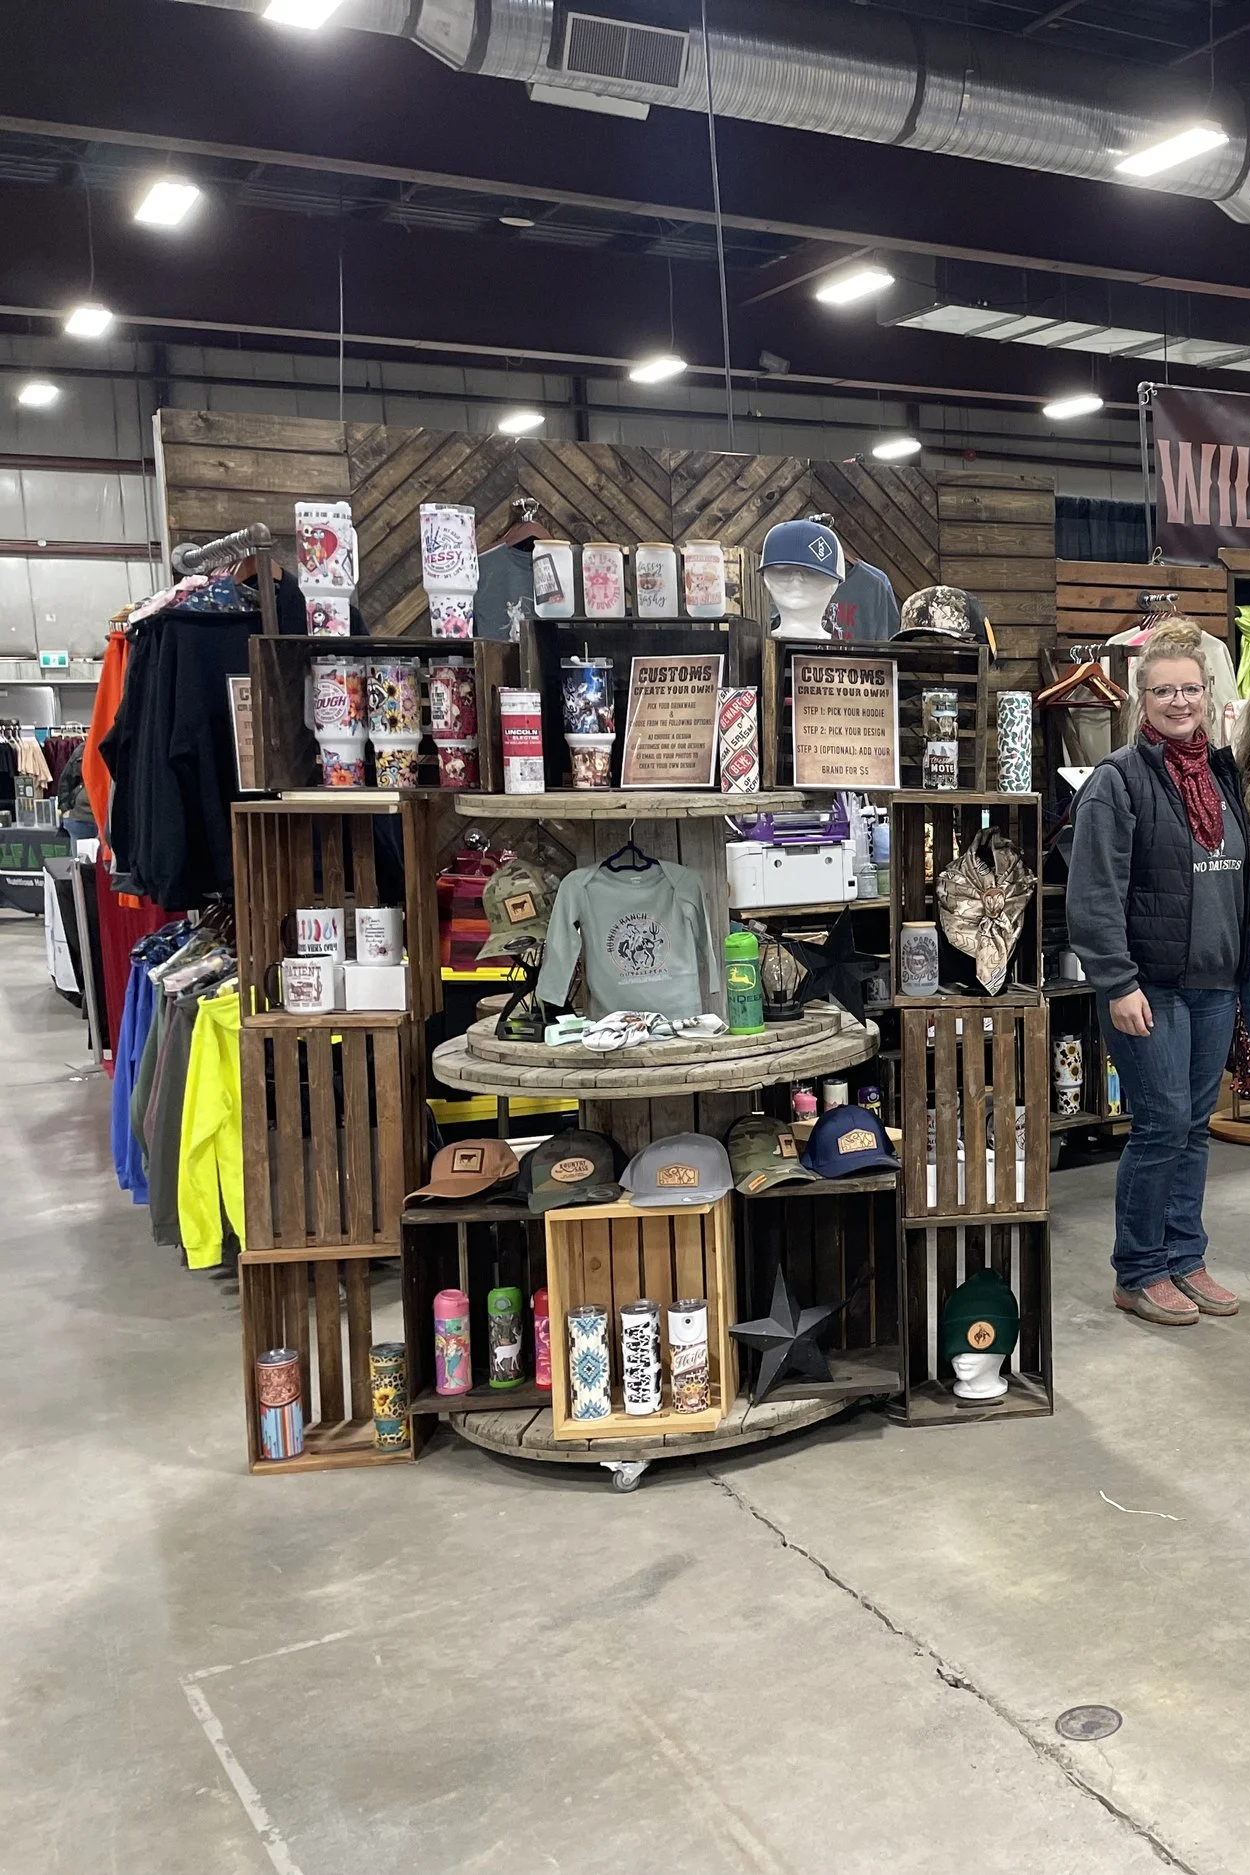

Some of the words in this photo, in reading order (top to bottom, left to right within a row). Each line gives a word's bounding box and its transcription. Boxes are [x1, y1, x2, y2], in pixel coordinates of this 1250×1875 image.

[638, 665, 712, 683] CUSTOMS
[801, 666, 885, 686] CUSTOMS
[634, 686, 666, 696] CREATE
[667, 685, 689, 695] YOUR
[797, 686, 835, 696] CREATE
[837, 687, 861, 697] YOUR
[863, 688, 890, 697] OWN!
[316, 696, 347, 709] OUGH
[803, 706, 819, 715] STEP
[827, 707, 841, 716] PICK
[843, 708, 860, 717] YOUR
[862, 708, 885, 718] HOODIE
[803, 726, 818, 734] STEP
[820, 726, 827, 735] 2:
[829, 726, 842, 735] PICK
[845, 727, 861, 736] YOUR
[863, 728, 886, 736] DESIGN
[797, 745, 811, 753] STEP
[814, 746, 818, 754] 3
[859, 747, 872, 755] ADD
[874, 747, 890, 756] YOUR
[822, 766, 843, 775] BRAND
[845, 767, 858, 775] FOR
[1193, 861, 1207, 873] NO
[1208, 860, 1242, 872] DAISIES
